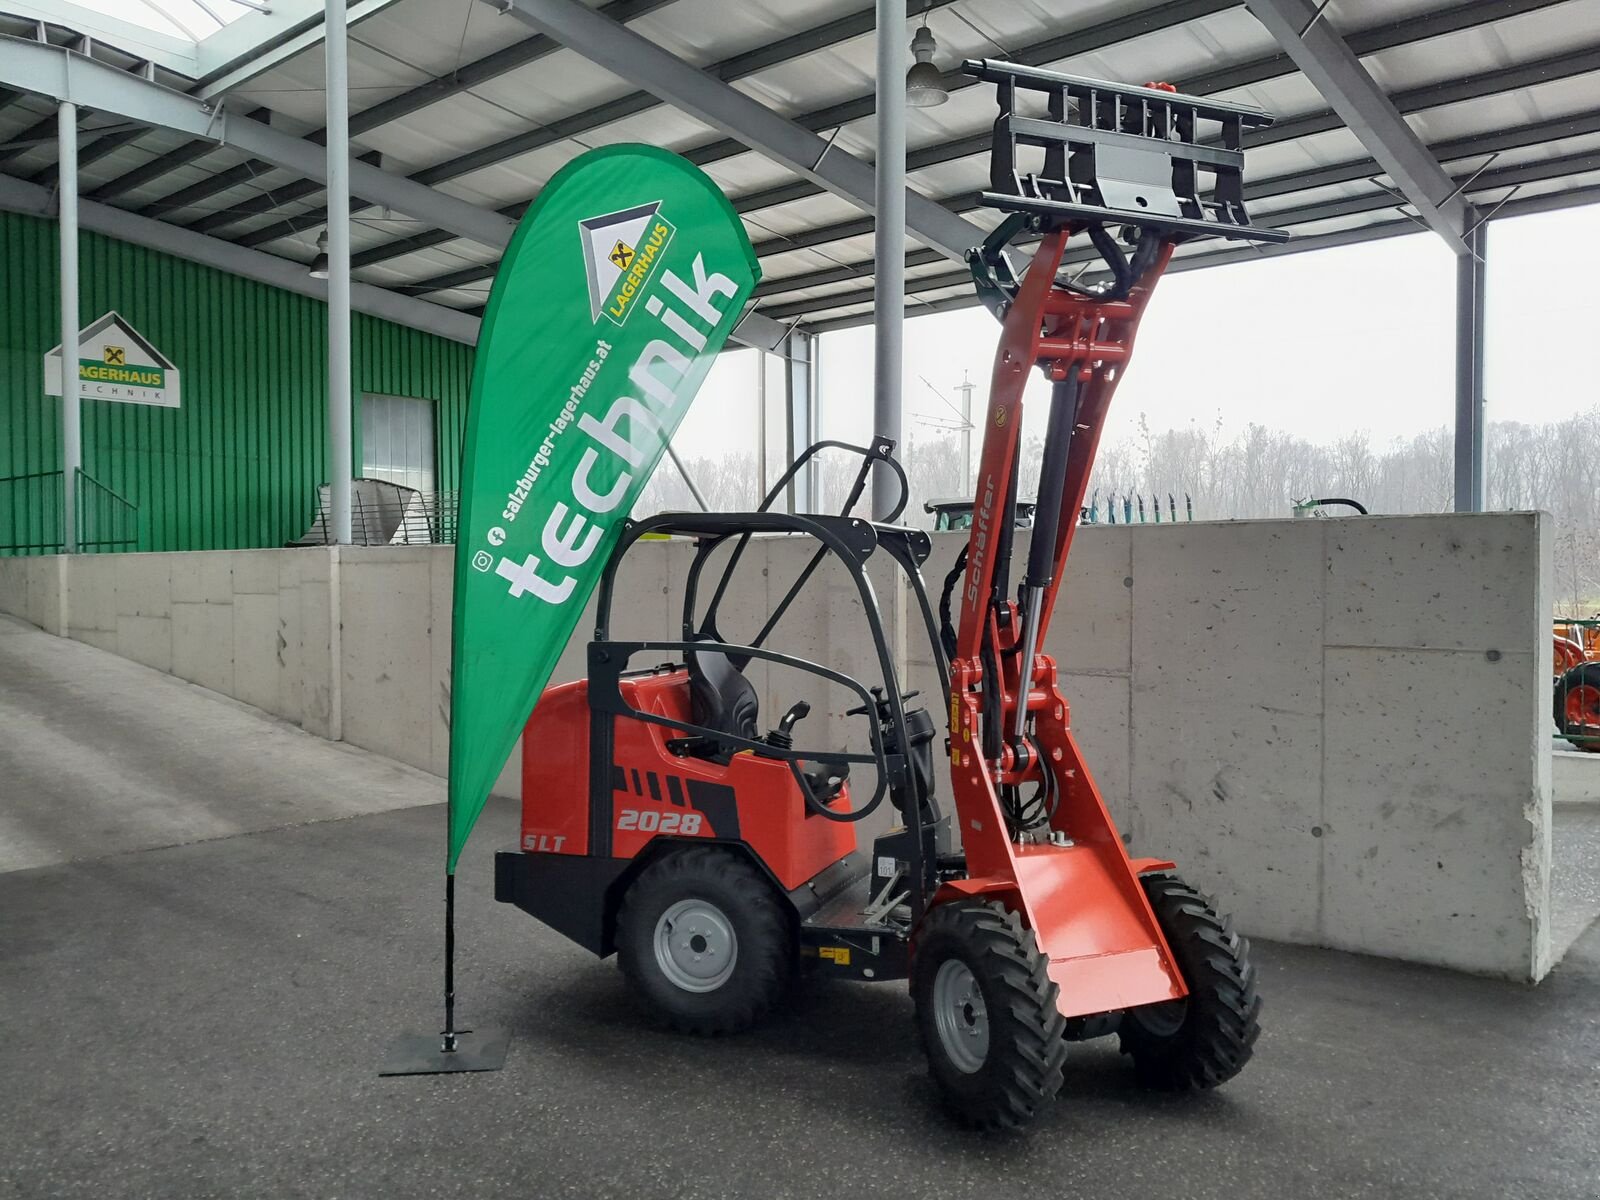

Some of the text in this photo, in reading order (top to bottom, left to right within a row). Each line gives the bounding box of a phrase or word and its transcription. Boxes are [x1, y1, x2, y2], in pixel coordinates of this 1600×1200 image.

[609, 222, 668, 317] LAGERHAUS
[79, 364, 161, 385] AGERHAUS
[81, 384, 160, 399] ECHNIK
[495, 251, 739, 604] technik
[502, 339, 613, 522] salzburger-lagerhaus.at
[967, 474, 995, 612] Schäffer
[522, 834, 567, 852] SLT
[617, 809, 702, 835] 2028
